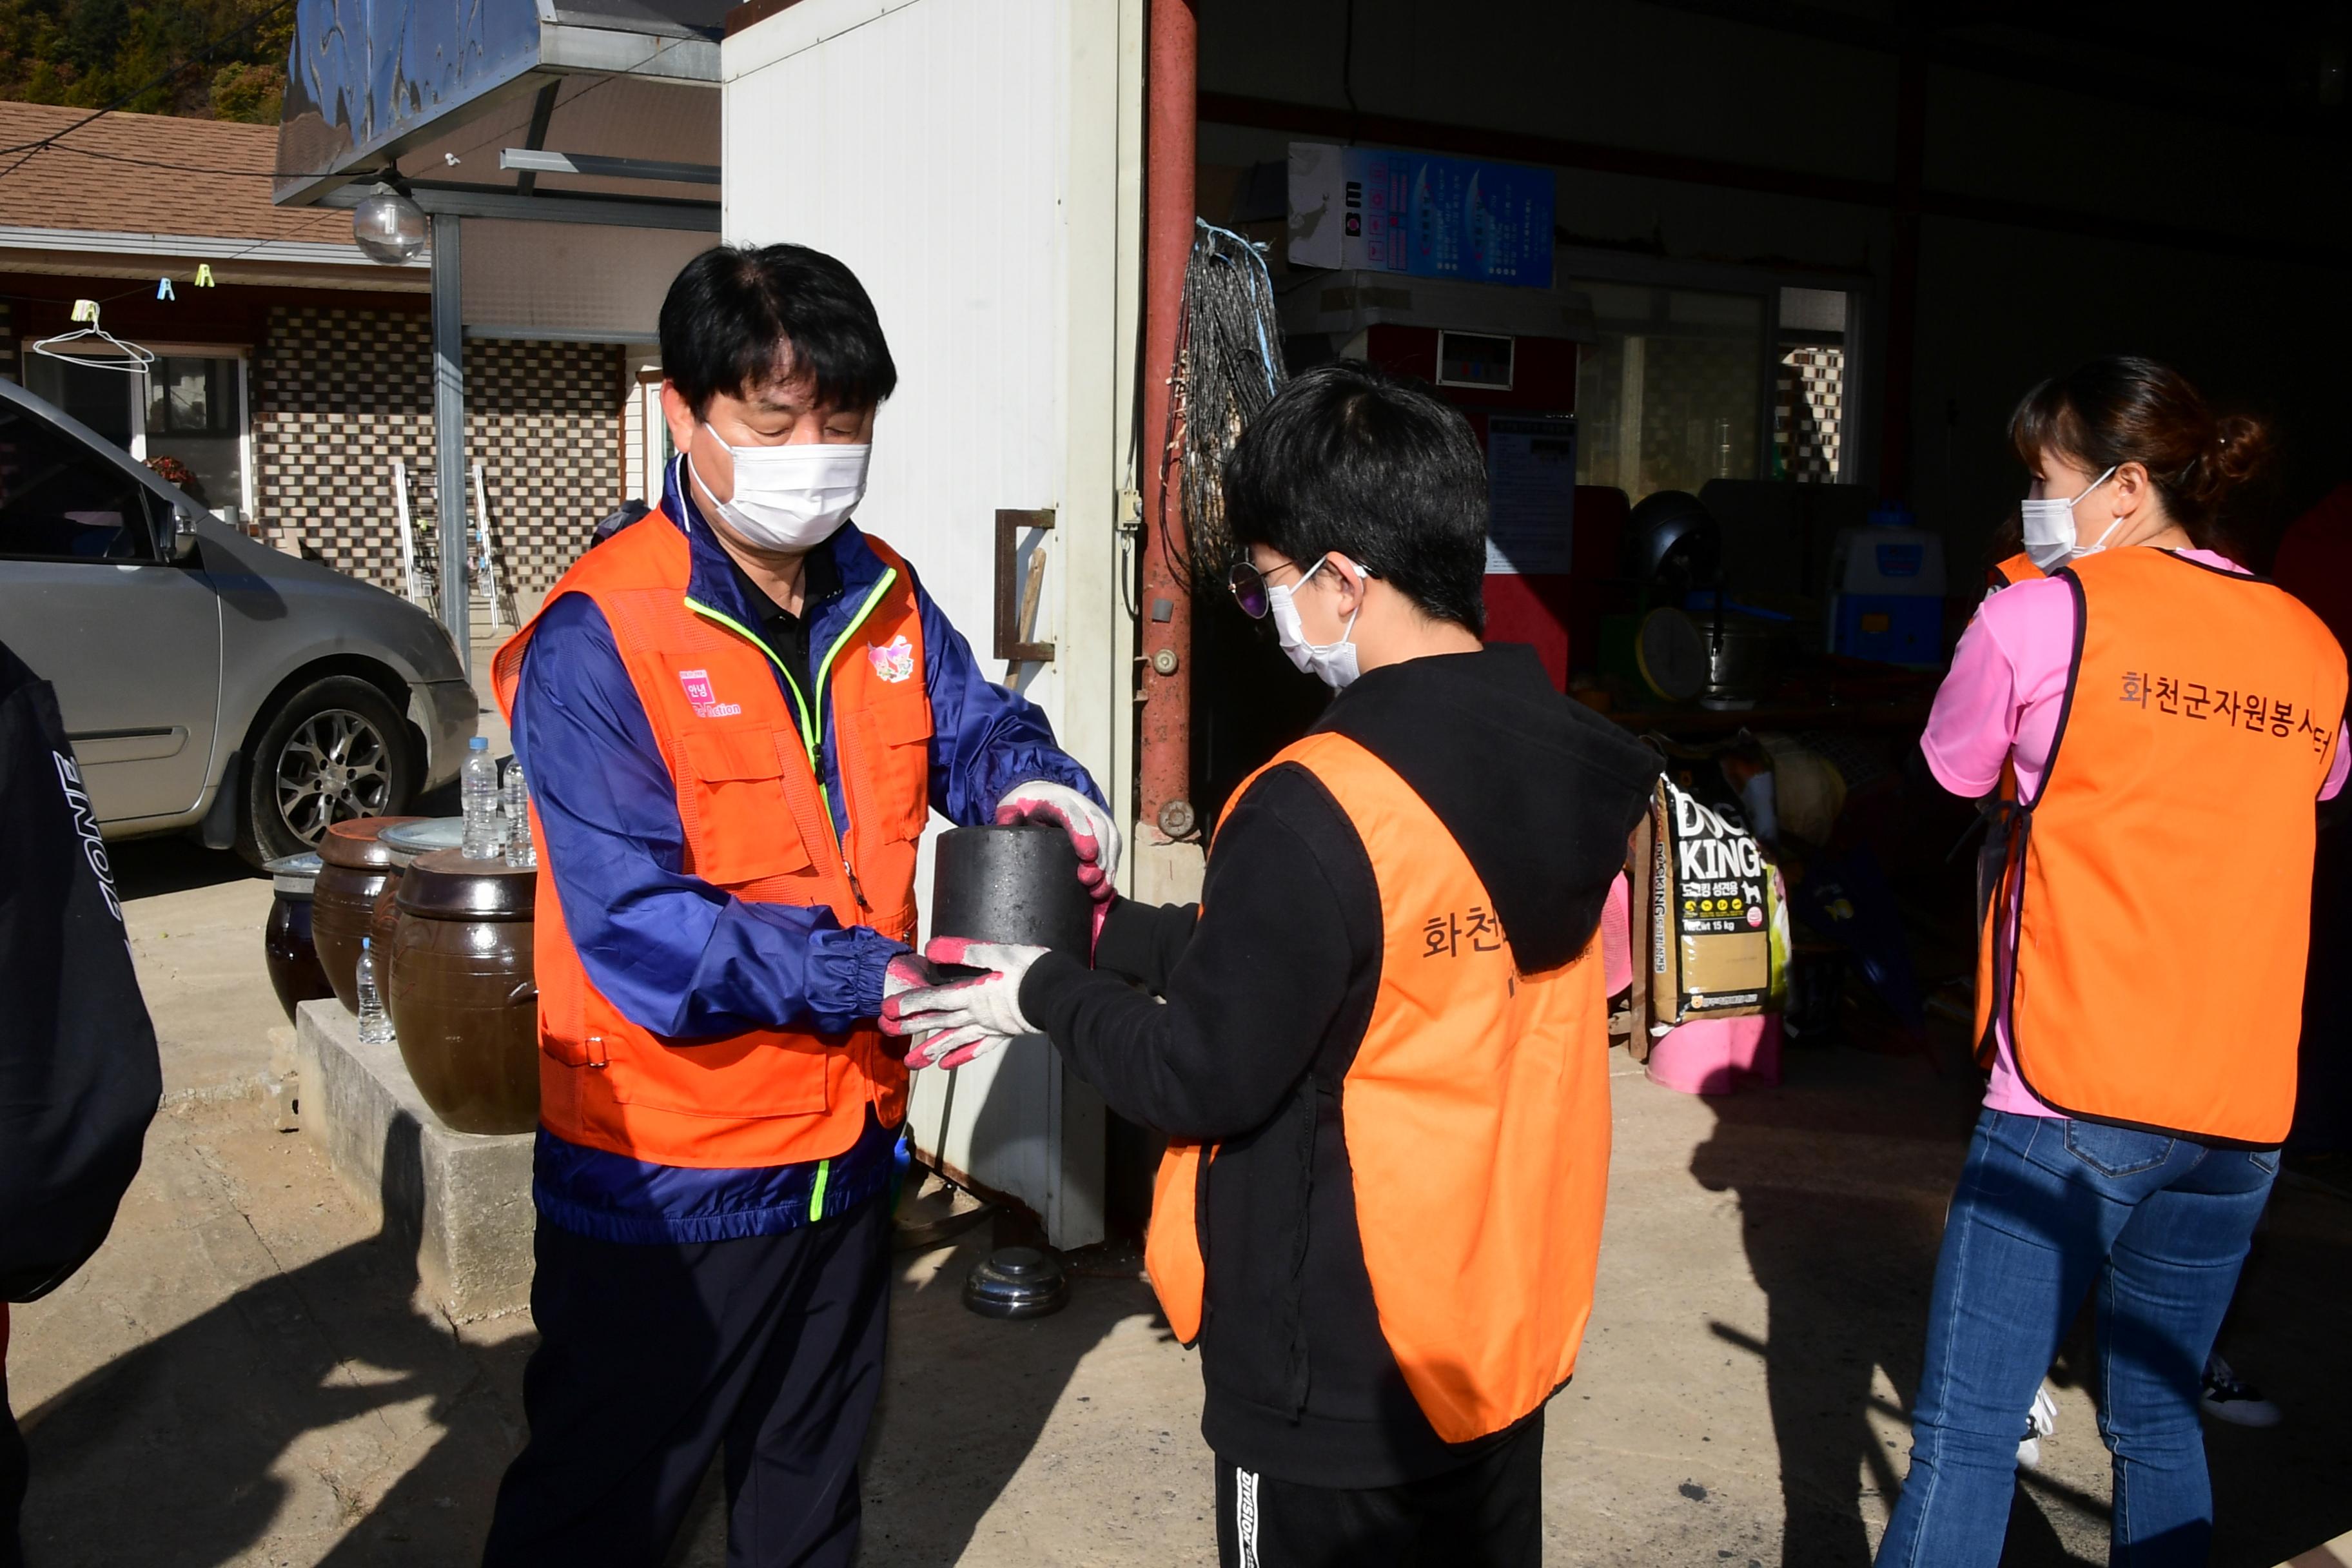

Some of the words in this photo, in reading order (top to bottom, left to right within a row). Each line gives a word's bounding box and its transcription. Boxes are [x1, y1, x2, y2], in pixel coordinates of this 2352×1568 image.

[687, 683, 708, 698] 안녕
[1676, 792, 1749, 839] DOG
[1679, 837, 1762, 880] KING
[1712, 881, 1739, 897] 성견용
[1712, 921, 1722, 930] 15
[1723, 920, 1735, 932] kg
[1241, 1471, 1254, 1547] DIVISION
